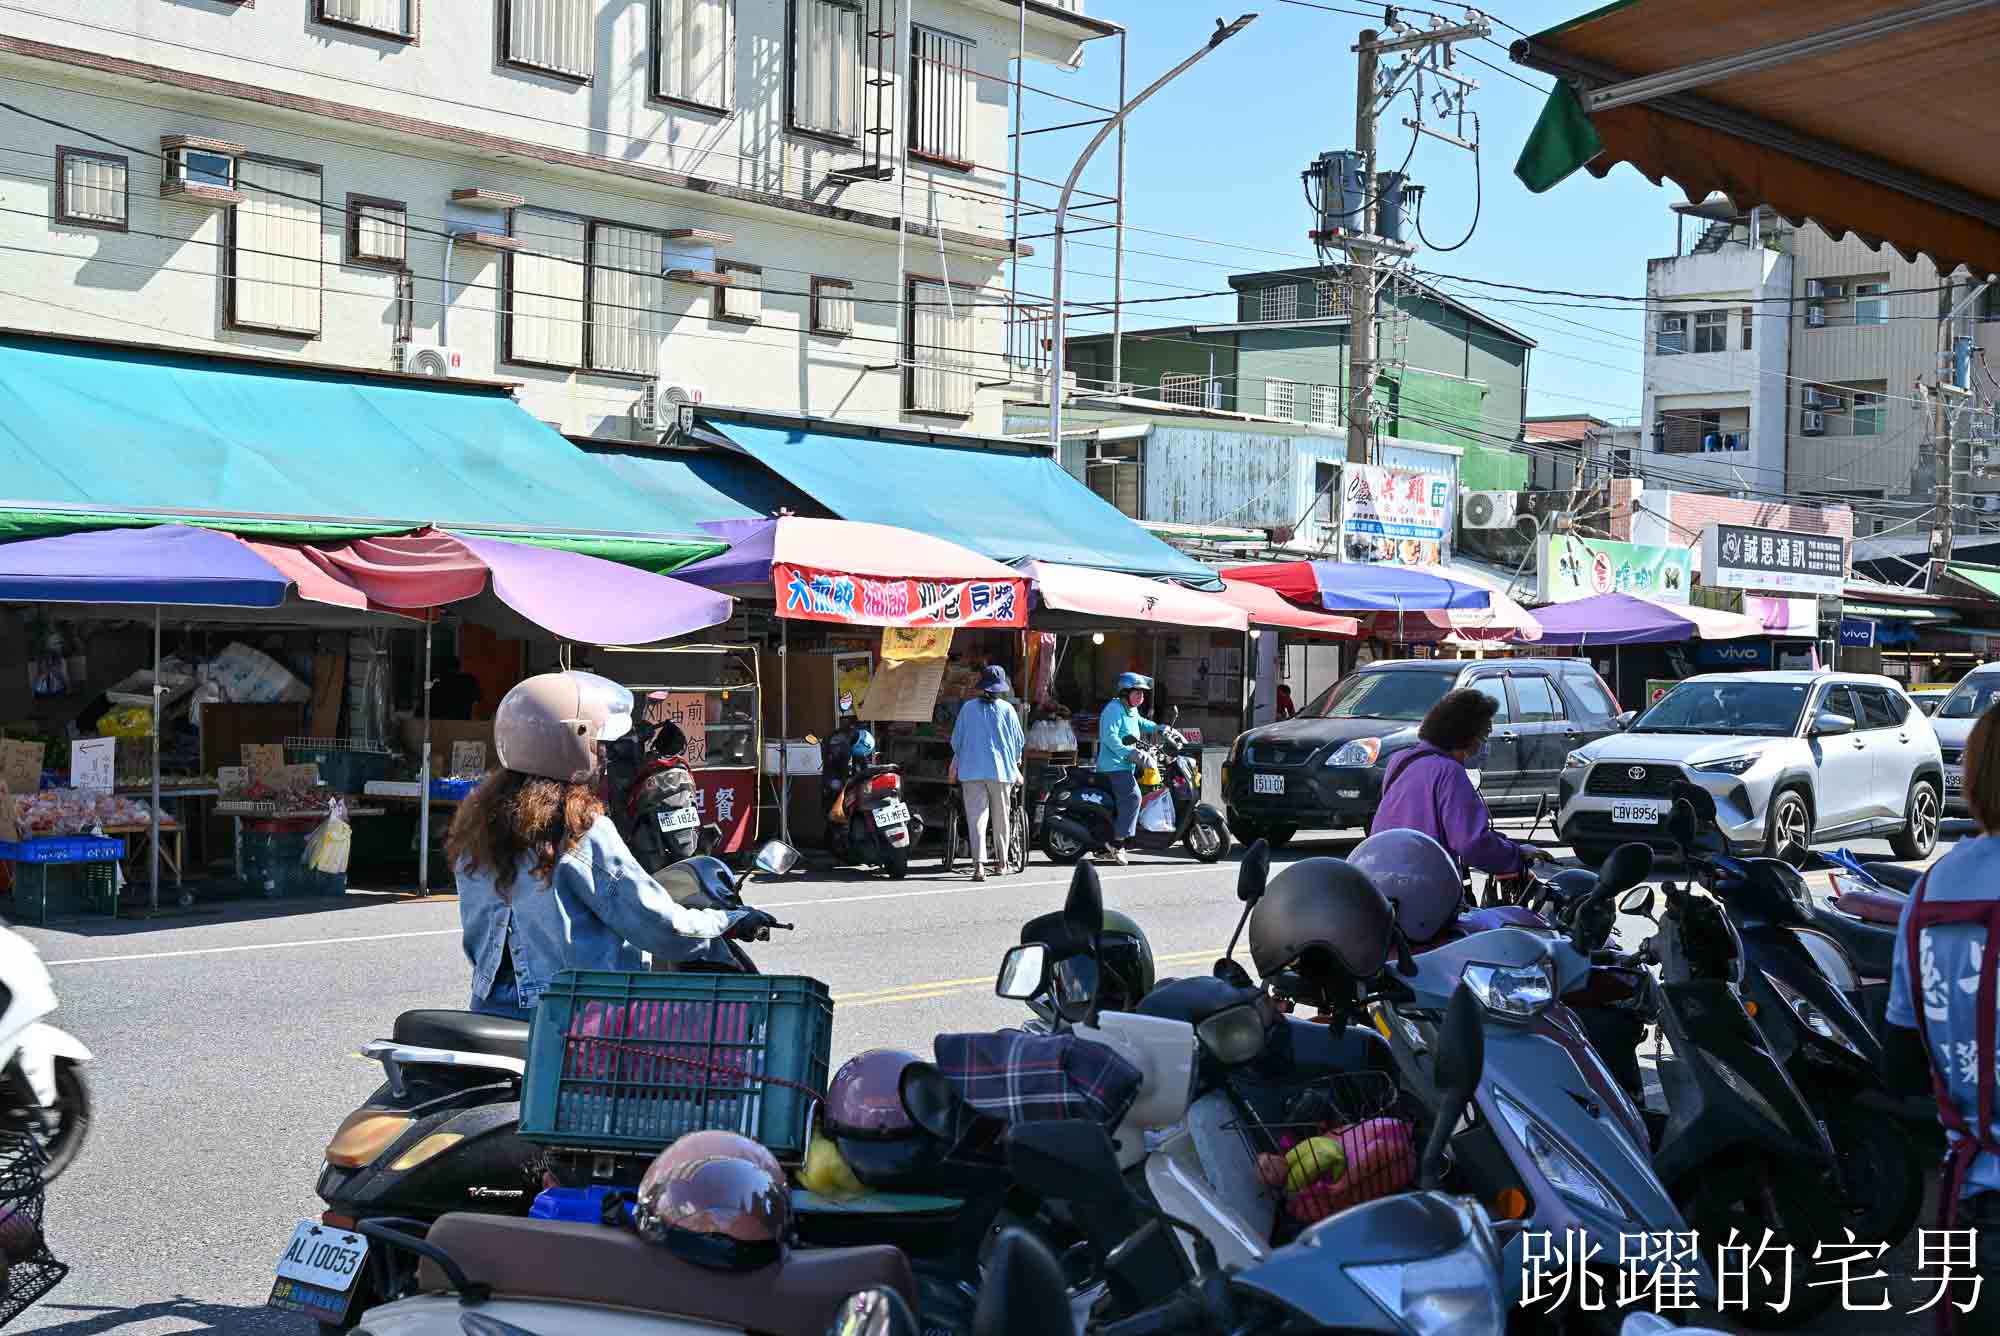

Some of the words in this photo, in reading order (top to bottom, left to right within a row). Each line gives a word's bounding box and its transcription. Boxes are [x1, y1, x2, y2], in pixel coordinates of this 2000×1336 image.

[1743, 534, 1806, 569] 誠恩通訊
[787, 570, 855, 617] 大煎餃
[863, 579, 909, 618] 油飯
[968, 581, 1016, 622] 豆漿
[1842, 629, 1869, 639] vivo
[1717, 645, 1758, 659] vivo
[687, 699, 705, 763] 煎餃
